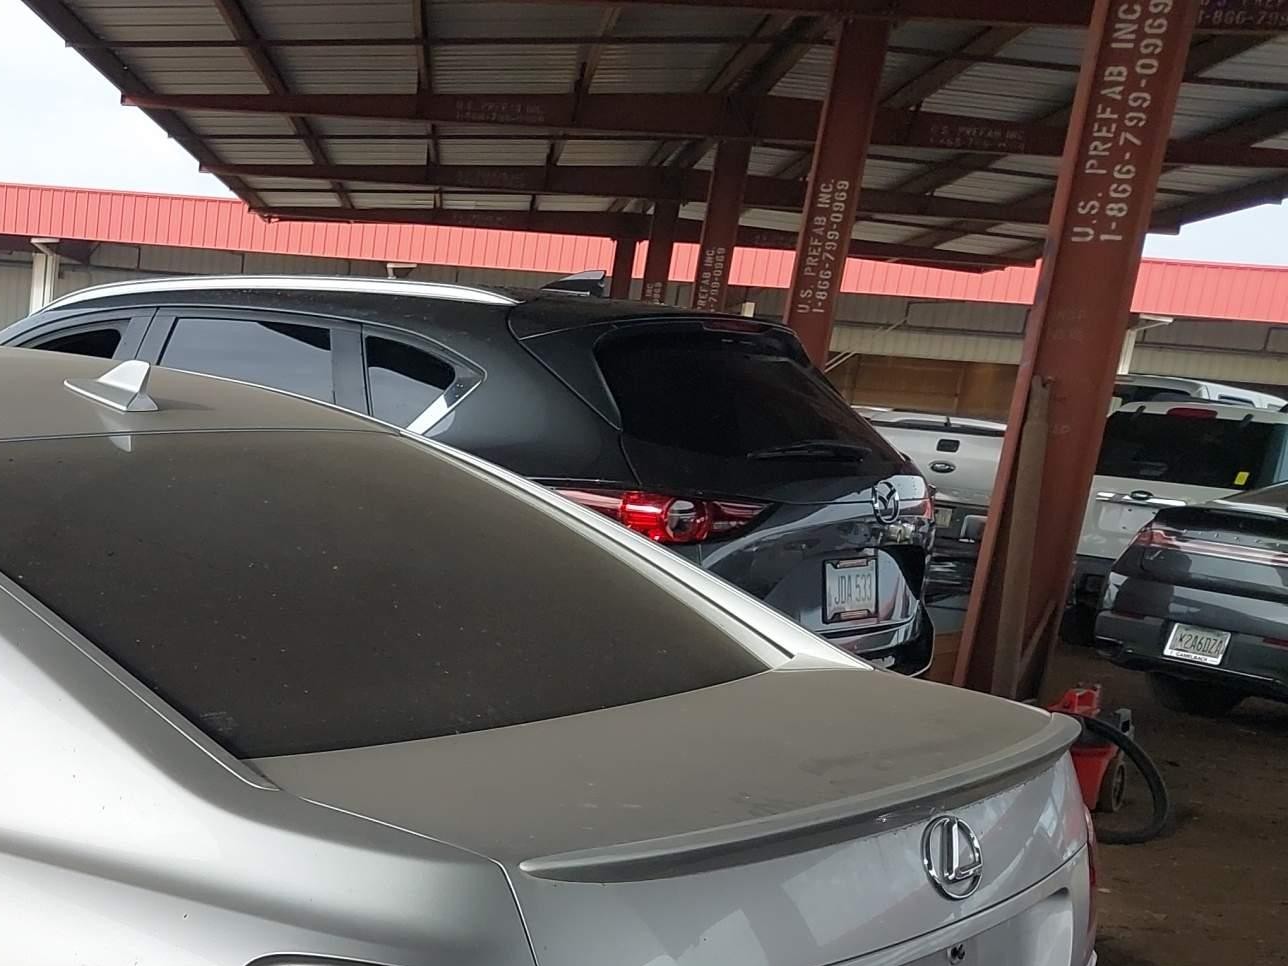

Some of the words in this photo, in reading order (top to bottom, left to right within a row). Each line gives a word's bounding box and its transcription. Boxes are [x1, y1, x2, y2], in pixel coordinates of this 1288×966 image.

[1085, 66, 1128, 174] PREFAB
[1100, 0, 1173, 241] 1-866-799-0969
[804, 216, 827, 275] PREFAB
[812, 180, 849, 313] 1-866-799-0969
[1072, 192, 1102, 242] U.S.
[797, 285, 813, 313] U.S.
[834, 574, 852, 605] JDA
